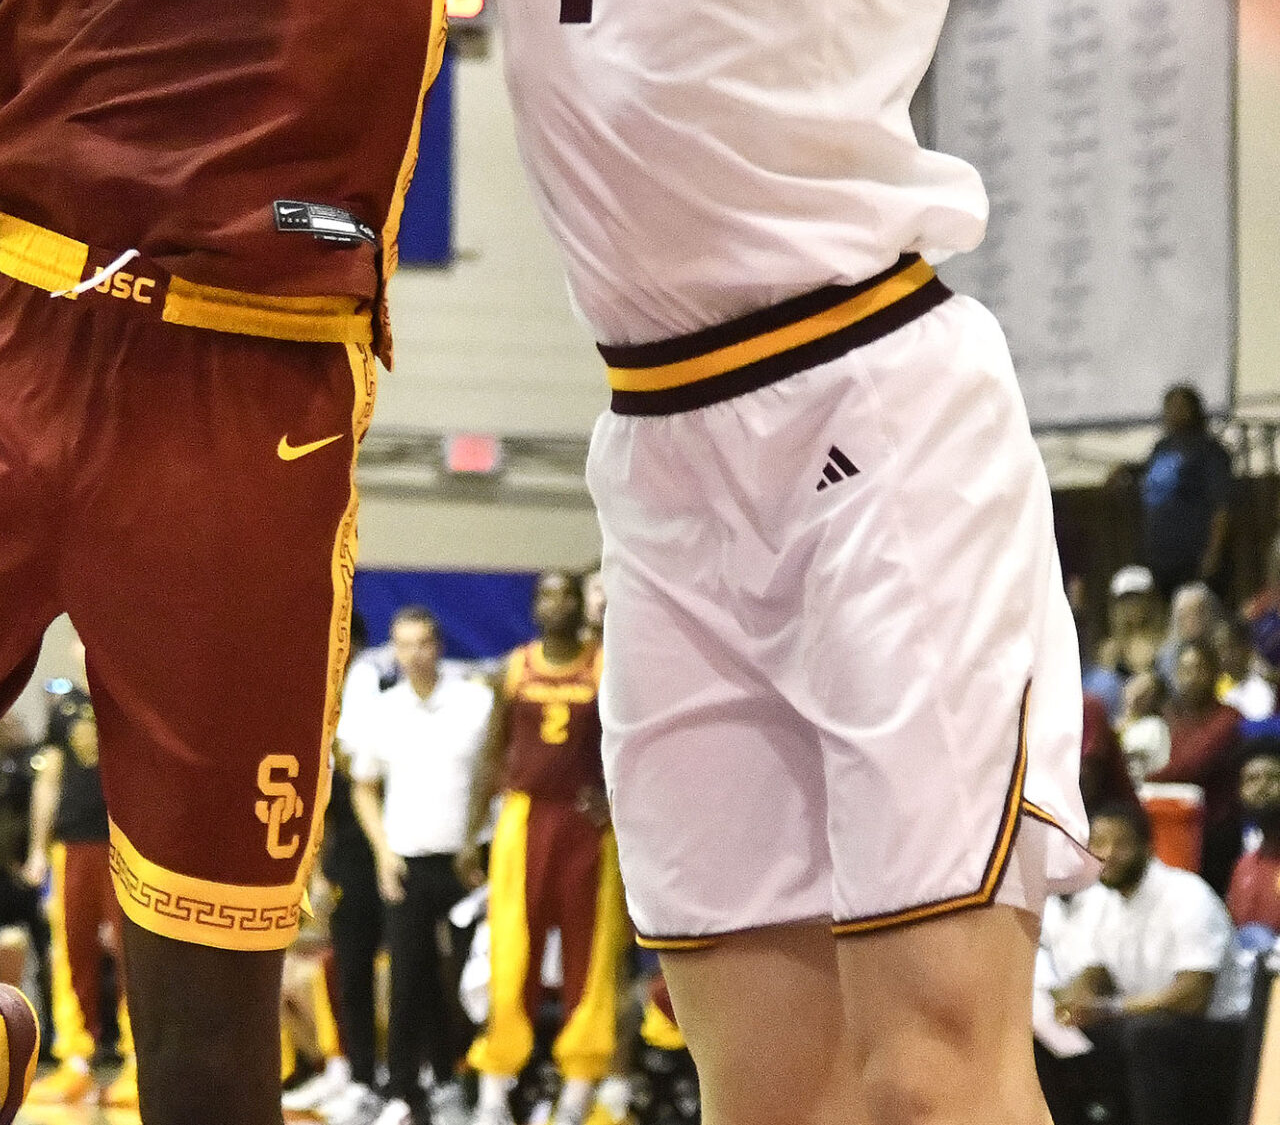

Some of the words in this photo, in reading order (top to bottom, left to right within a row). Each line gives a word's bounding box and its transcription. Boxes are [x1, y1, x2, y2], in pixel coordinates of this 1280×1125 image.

[94, 266, 156, 304] USC
[540, 702, 571, 745] 2
[255, 754, 304, 859] SC
